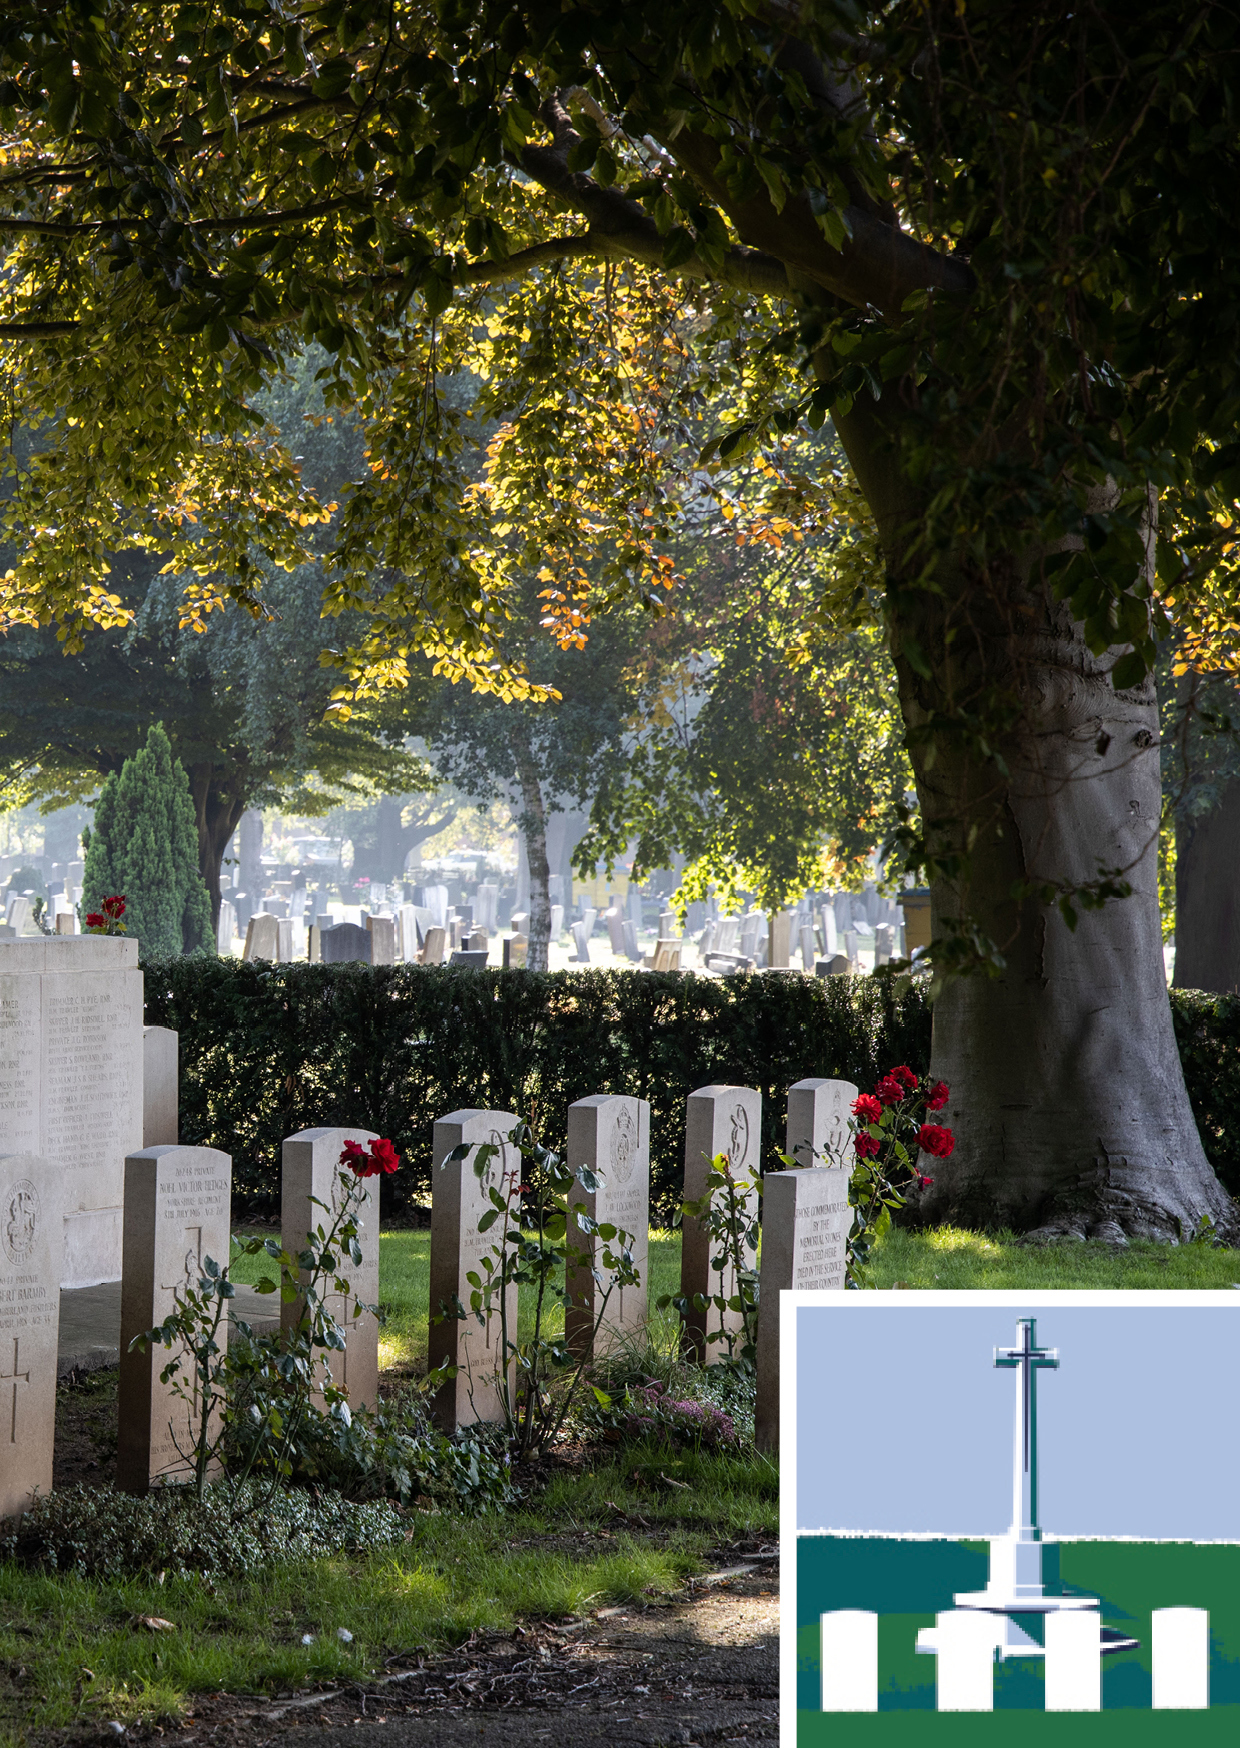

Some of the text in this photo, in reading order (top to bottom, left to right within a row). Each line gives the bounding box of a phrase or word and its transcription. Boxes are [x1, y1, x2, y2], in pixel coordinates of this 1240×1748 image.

[194, 1166, 215, 1176] PRIVATE
[160, 1182, 176, 1194] NOEL
[178, 1180, 203, 1193] VICTOR
[796, 1201, 848, 1219] THOSE COMMEMORATED
[813, 1219, 830, 1232] BY THE
[799, 1231, 841, 1248] MEMORIAL STONES
[803, 1246, 837, 1263] ERECTED HERE
[797, 1261, 842, 1279] DIED IN THE SERVICE
[819, 1276, 840, 1289] COUNTRY
[17, 1286, 46, 1301] BARMBY
